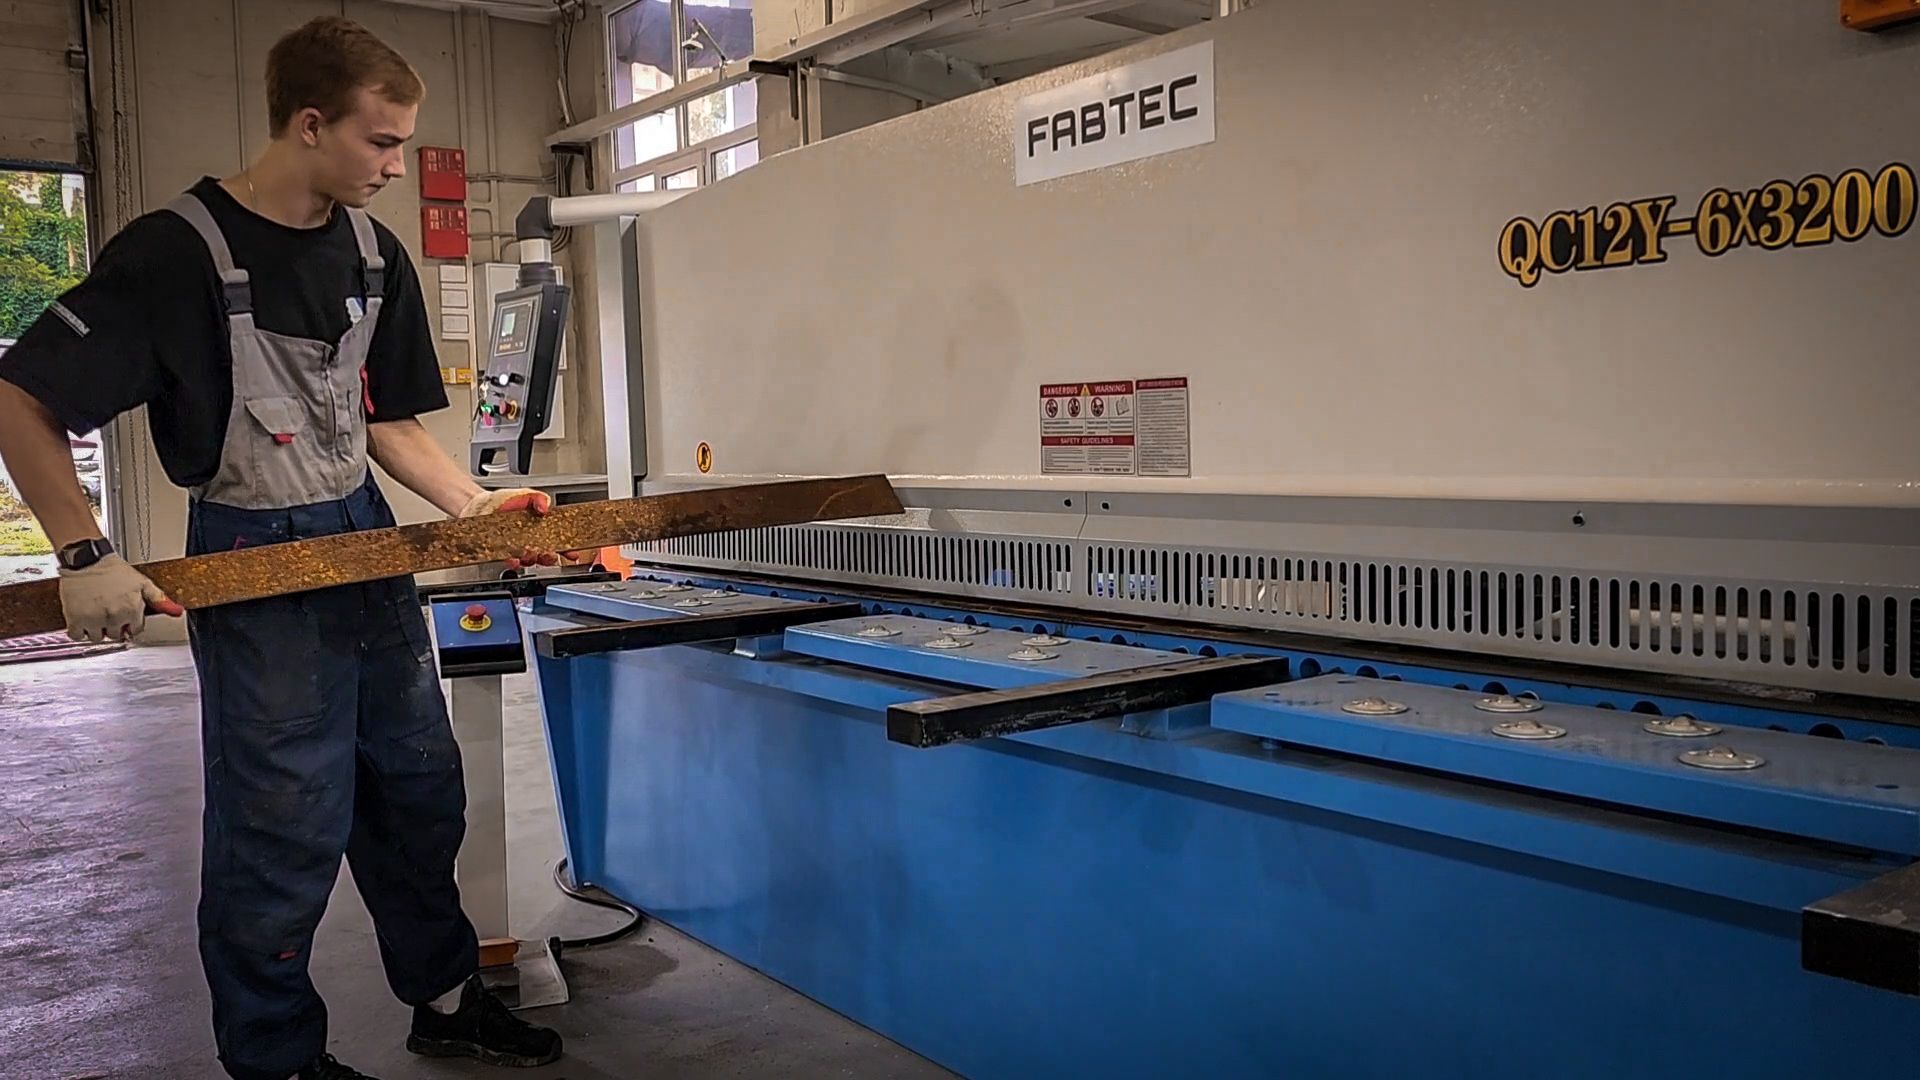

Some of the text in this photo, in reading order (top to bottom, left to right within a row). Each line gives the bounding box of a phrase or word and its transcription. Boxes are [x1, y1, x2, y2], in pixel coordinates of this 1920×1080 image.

[1027, 75, 1198, 157] FABTEC
[1043, 386, 1078, 395] DANGEROUS
[1094, 384, 1126, 393] WARNING
